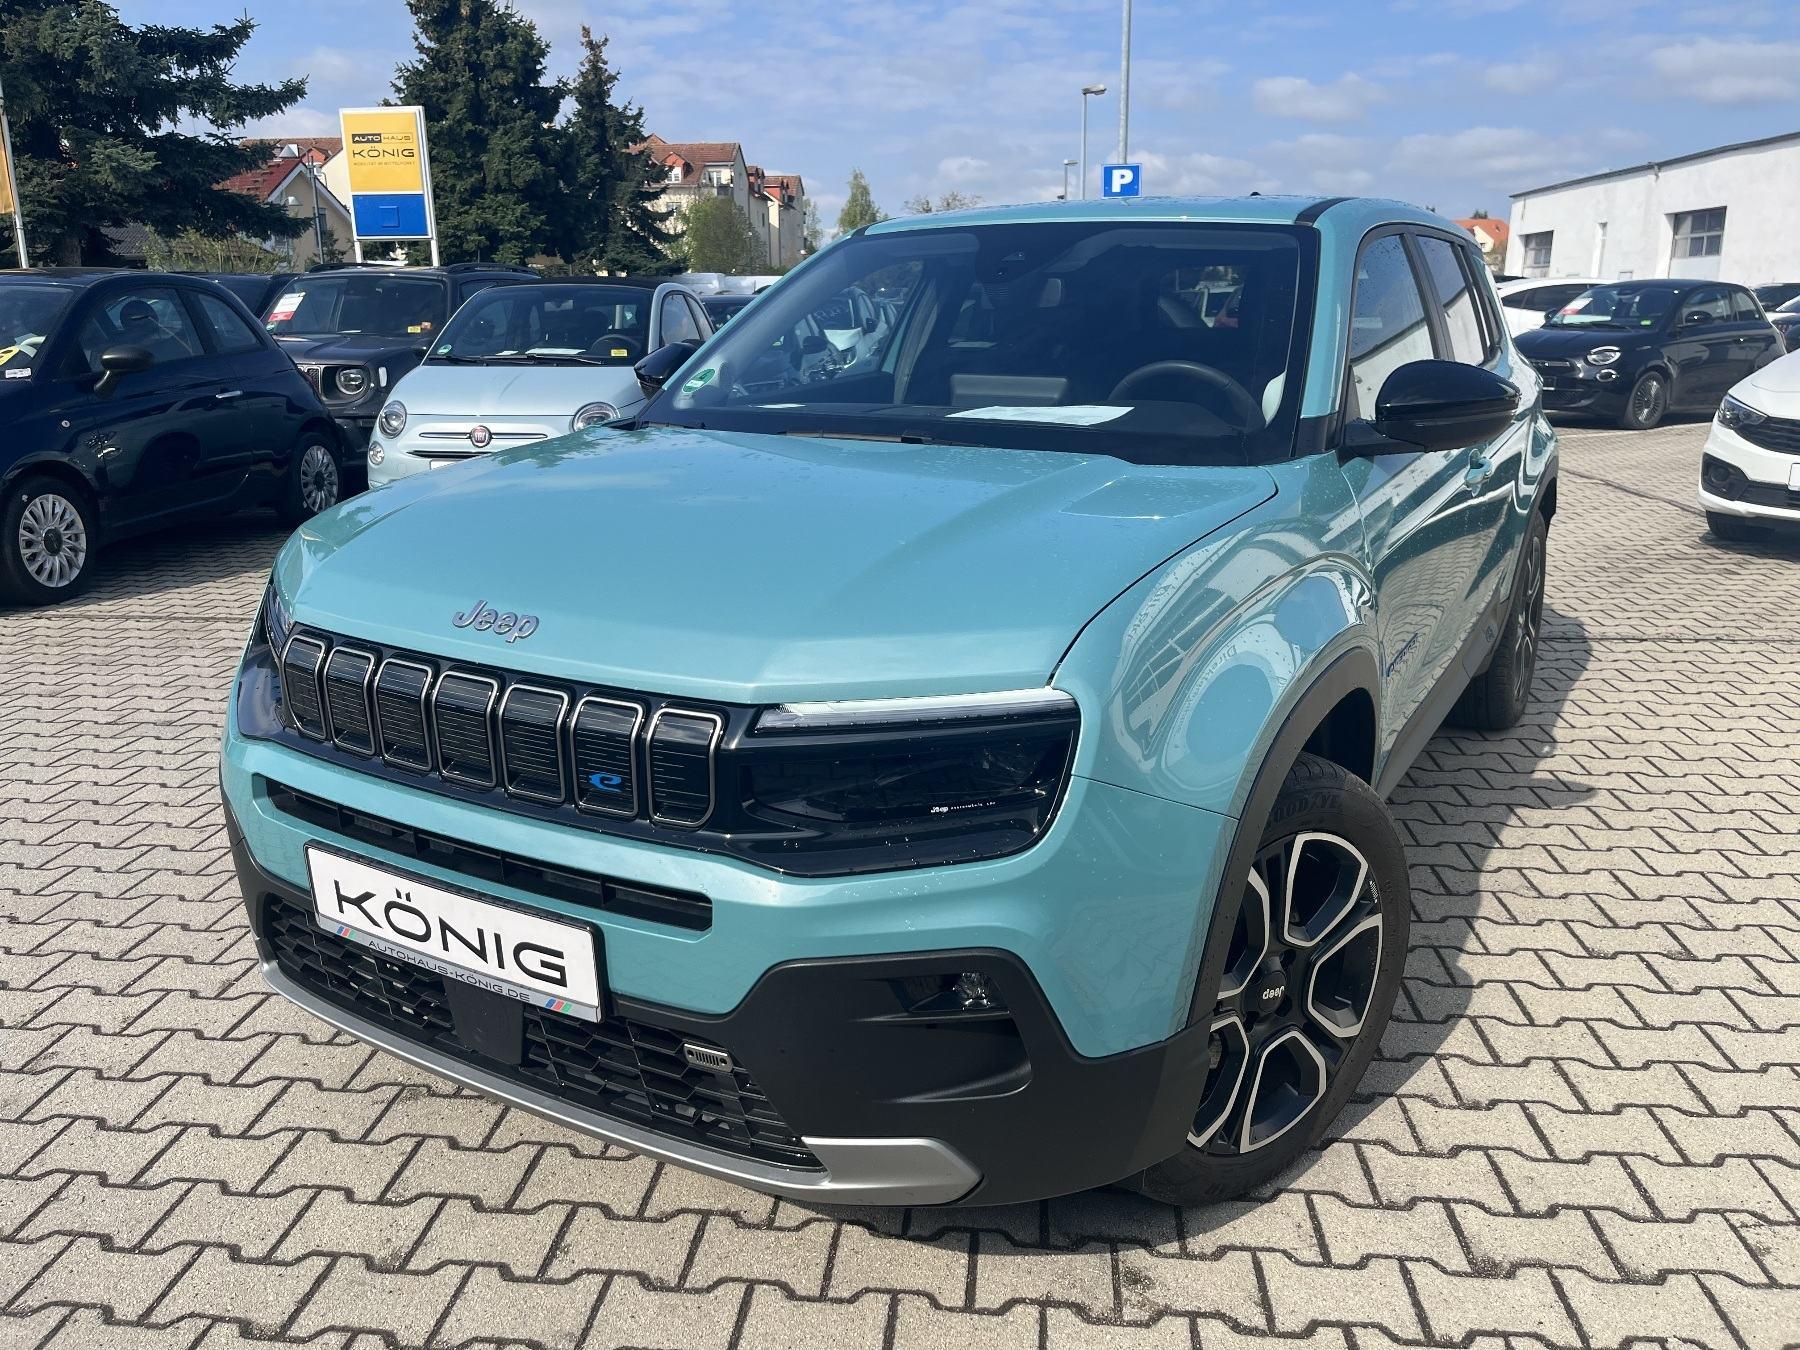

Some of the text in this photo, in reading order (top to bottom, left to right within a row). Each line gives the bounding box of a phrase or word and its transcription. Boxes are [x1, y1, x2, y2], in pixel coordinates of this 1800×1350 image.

[352, 145, 415, 159] KÖNIG
[1111, 169, 1134, 193] P
[452, 600, 540, 643] Jeep
[333, 879, 568, 989] KÖNIG
[368, 939, 531, 1002] AUTOHAUS-KÖNIG.DE
[1262, 985, 1285, 1000] Jeep
